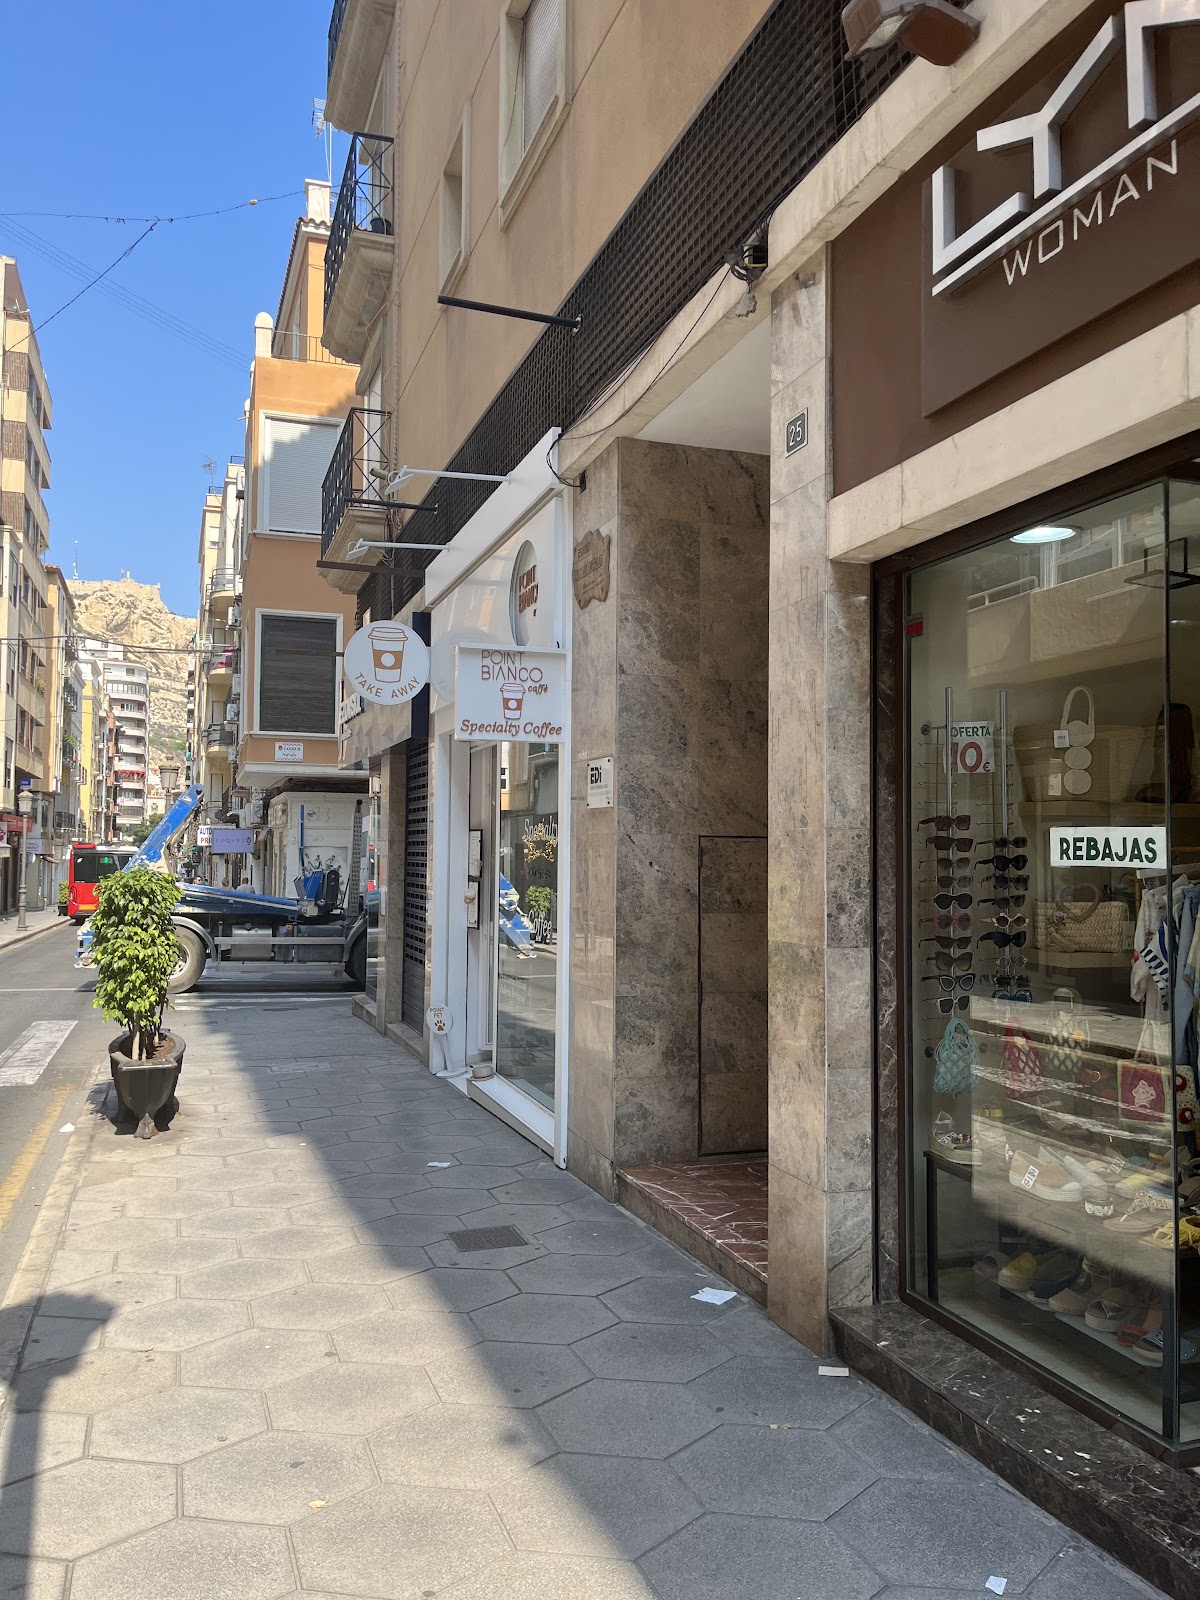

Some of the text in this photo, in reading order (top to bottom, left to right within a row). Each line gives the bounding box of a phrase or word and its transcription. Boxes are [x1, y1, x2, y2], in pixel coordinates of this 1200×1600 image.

[1002, 139, 1178, 286] WOMAN
[789, 420, 802, 447] 25
[481, 650, 525, 665] POINT
[481, 665, 543, 682] BIANCO
[354, 672, 420, 699] TAKE AWAY
[460, 719, 563, 738] Specialty Coffee
[950, 725, 991, 738] OFERTA
[1059, 836, 1158, 864] REBAJAS
